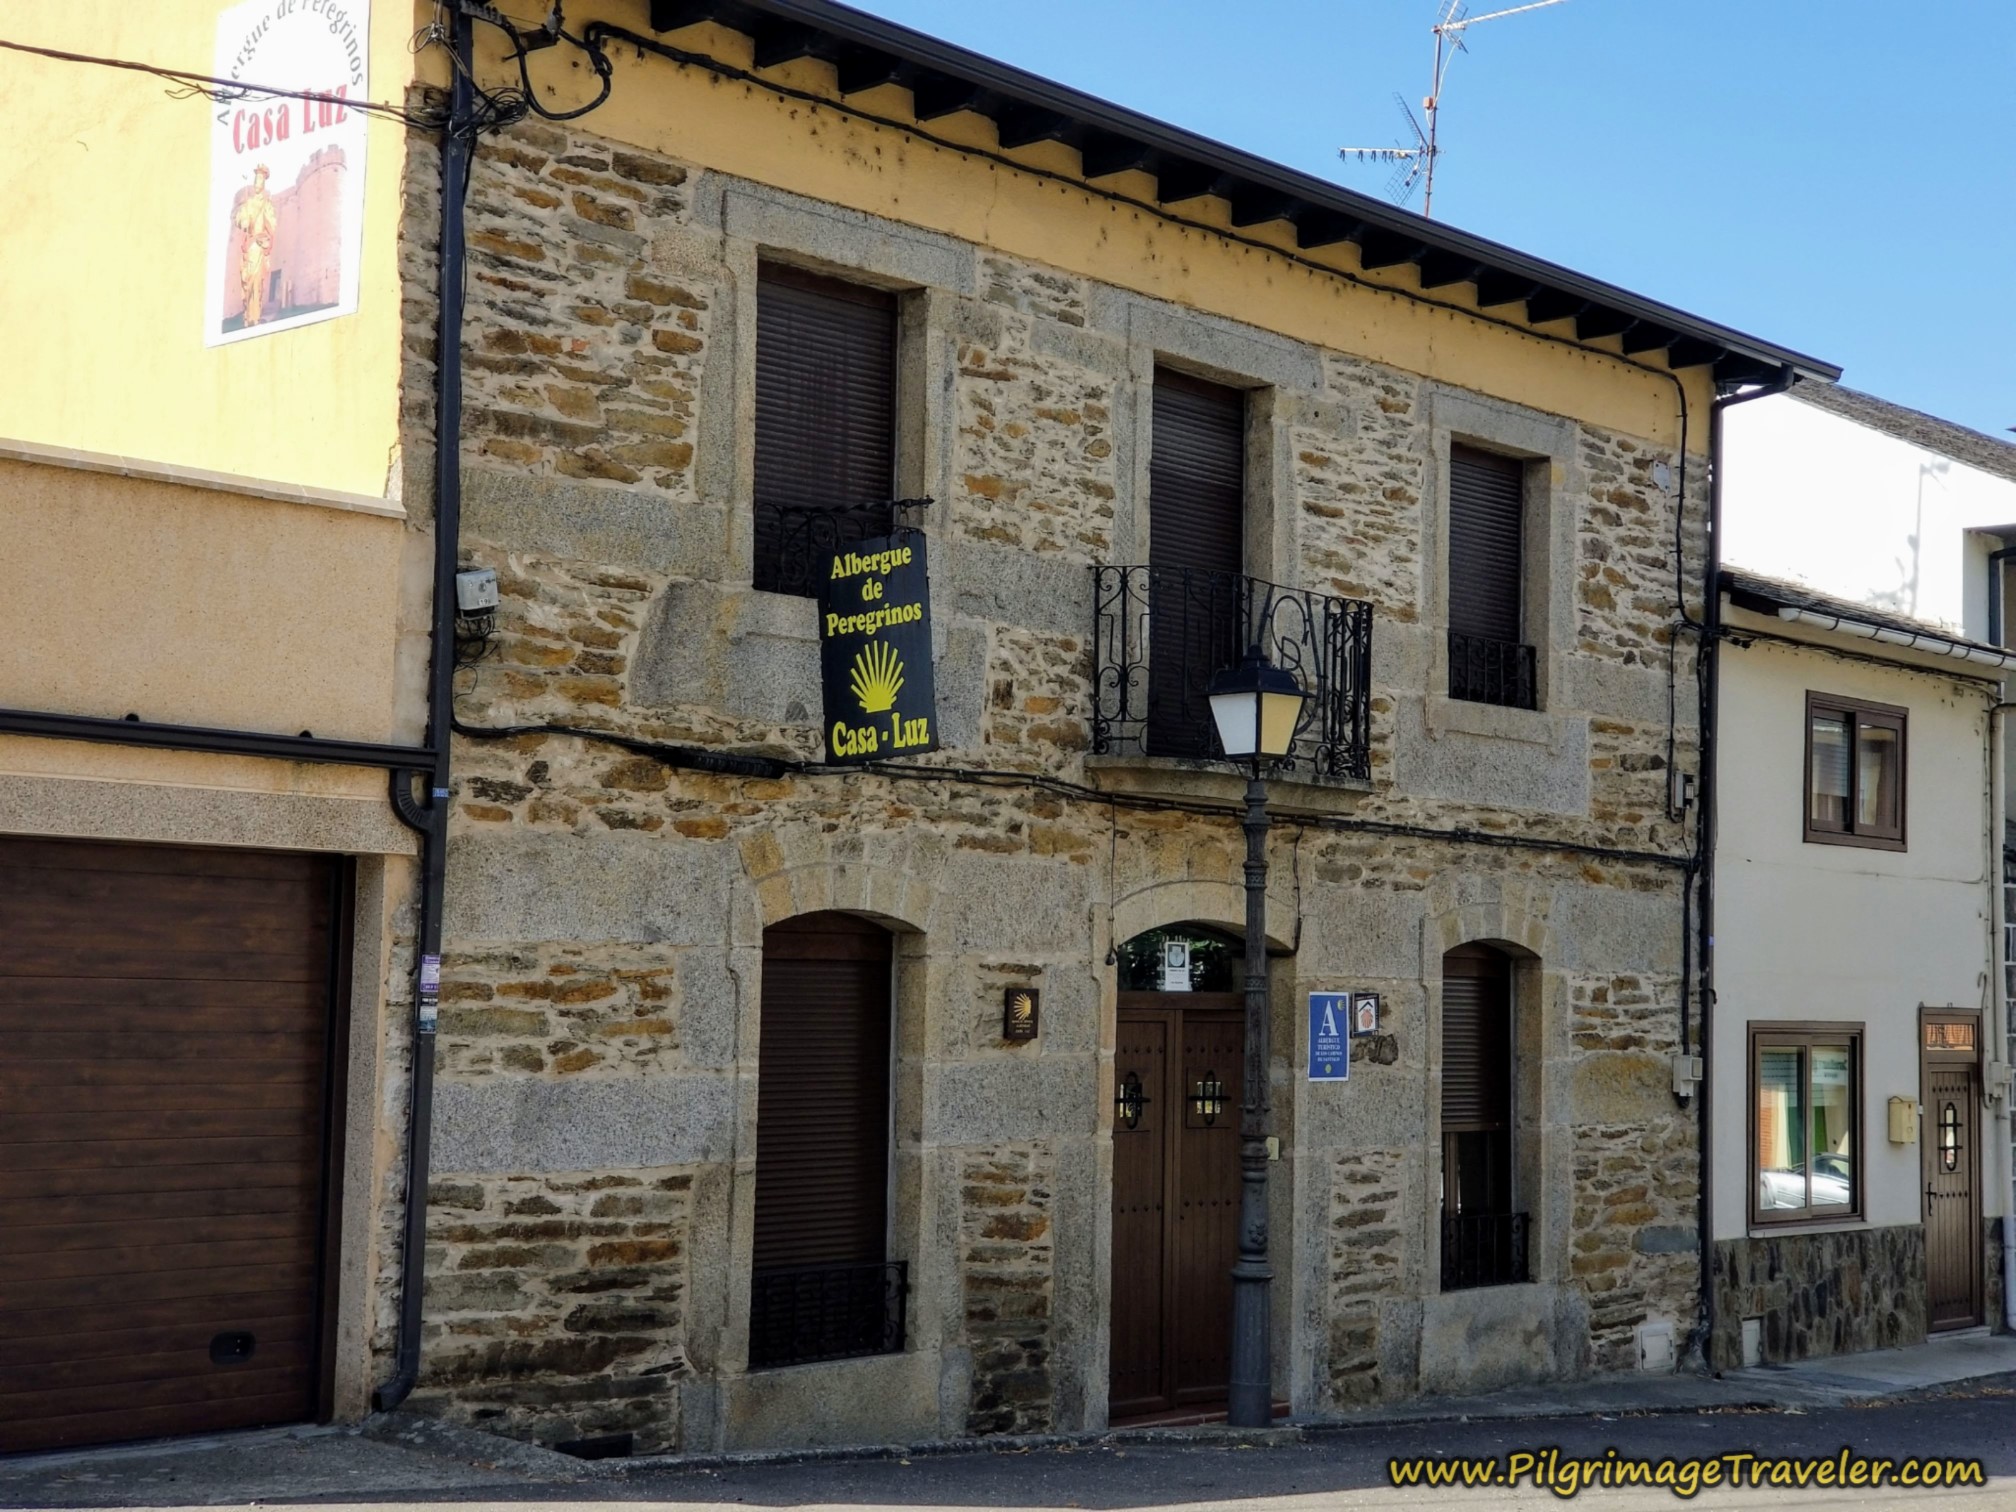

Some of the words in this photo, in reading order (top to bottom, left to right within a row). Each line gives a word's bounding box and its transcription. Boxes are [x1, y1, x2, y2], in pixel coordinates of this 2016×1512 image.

[232, 103, 290, 155] Casa
[302, 84, 348, 134] Luz
[830, 546, 912, 580] Albergue
[862, 577, 883, 601] de
[826, 602, 922, 637] Peregrinos
[1318, 1000, 1340, 1036] A
